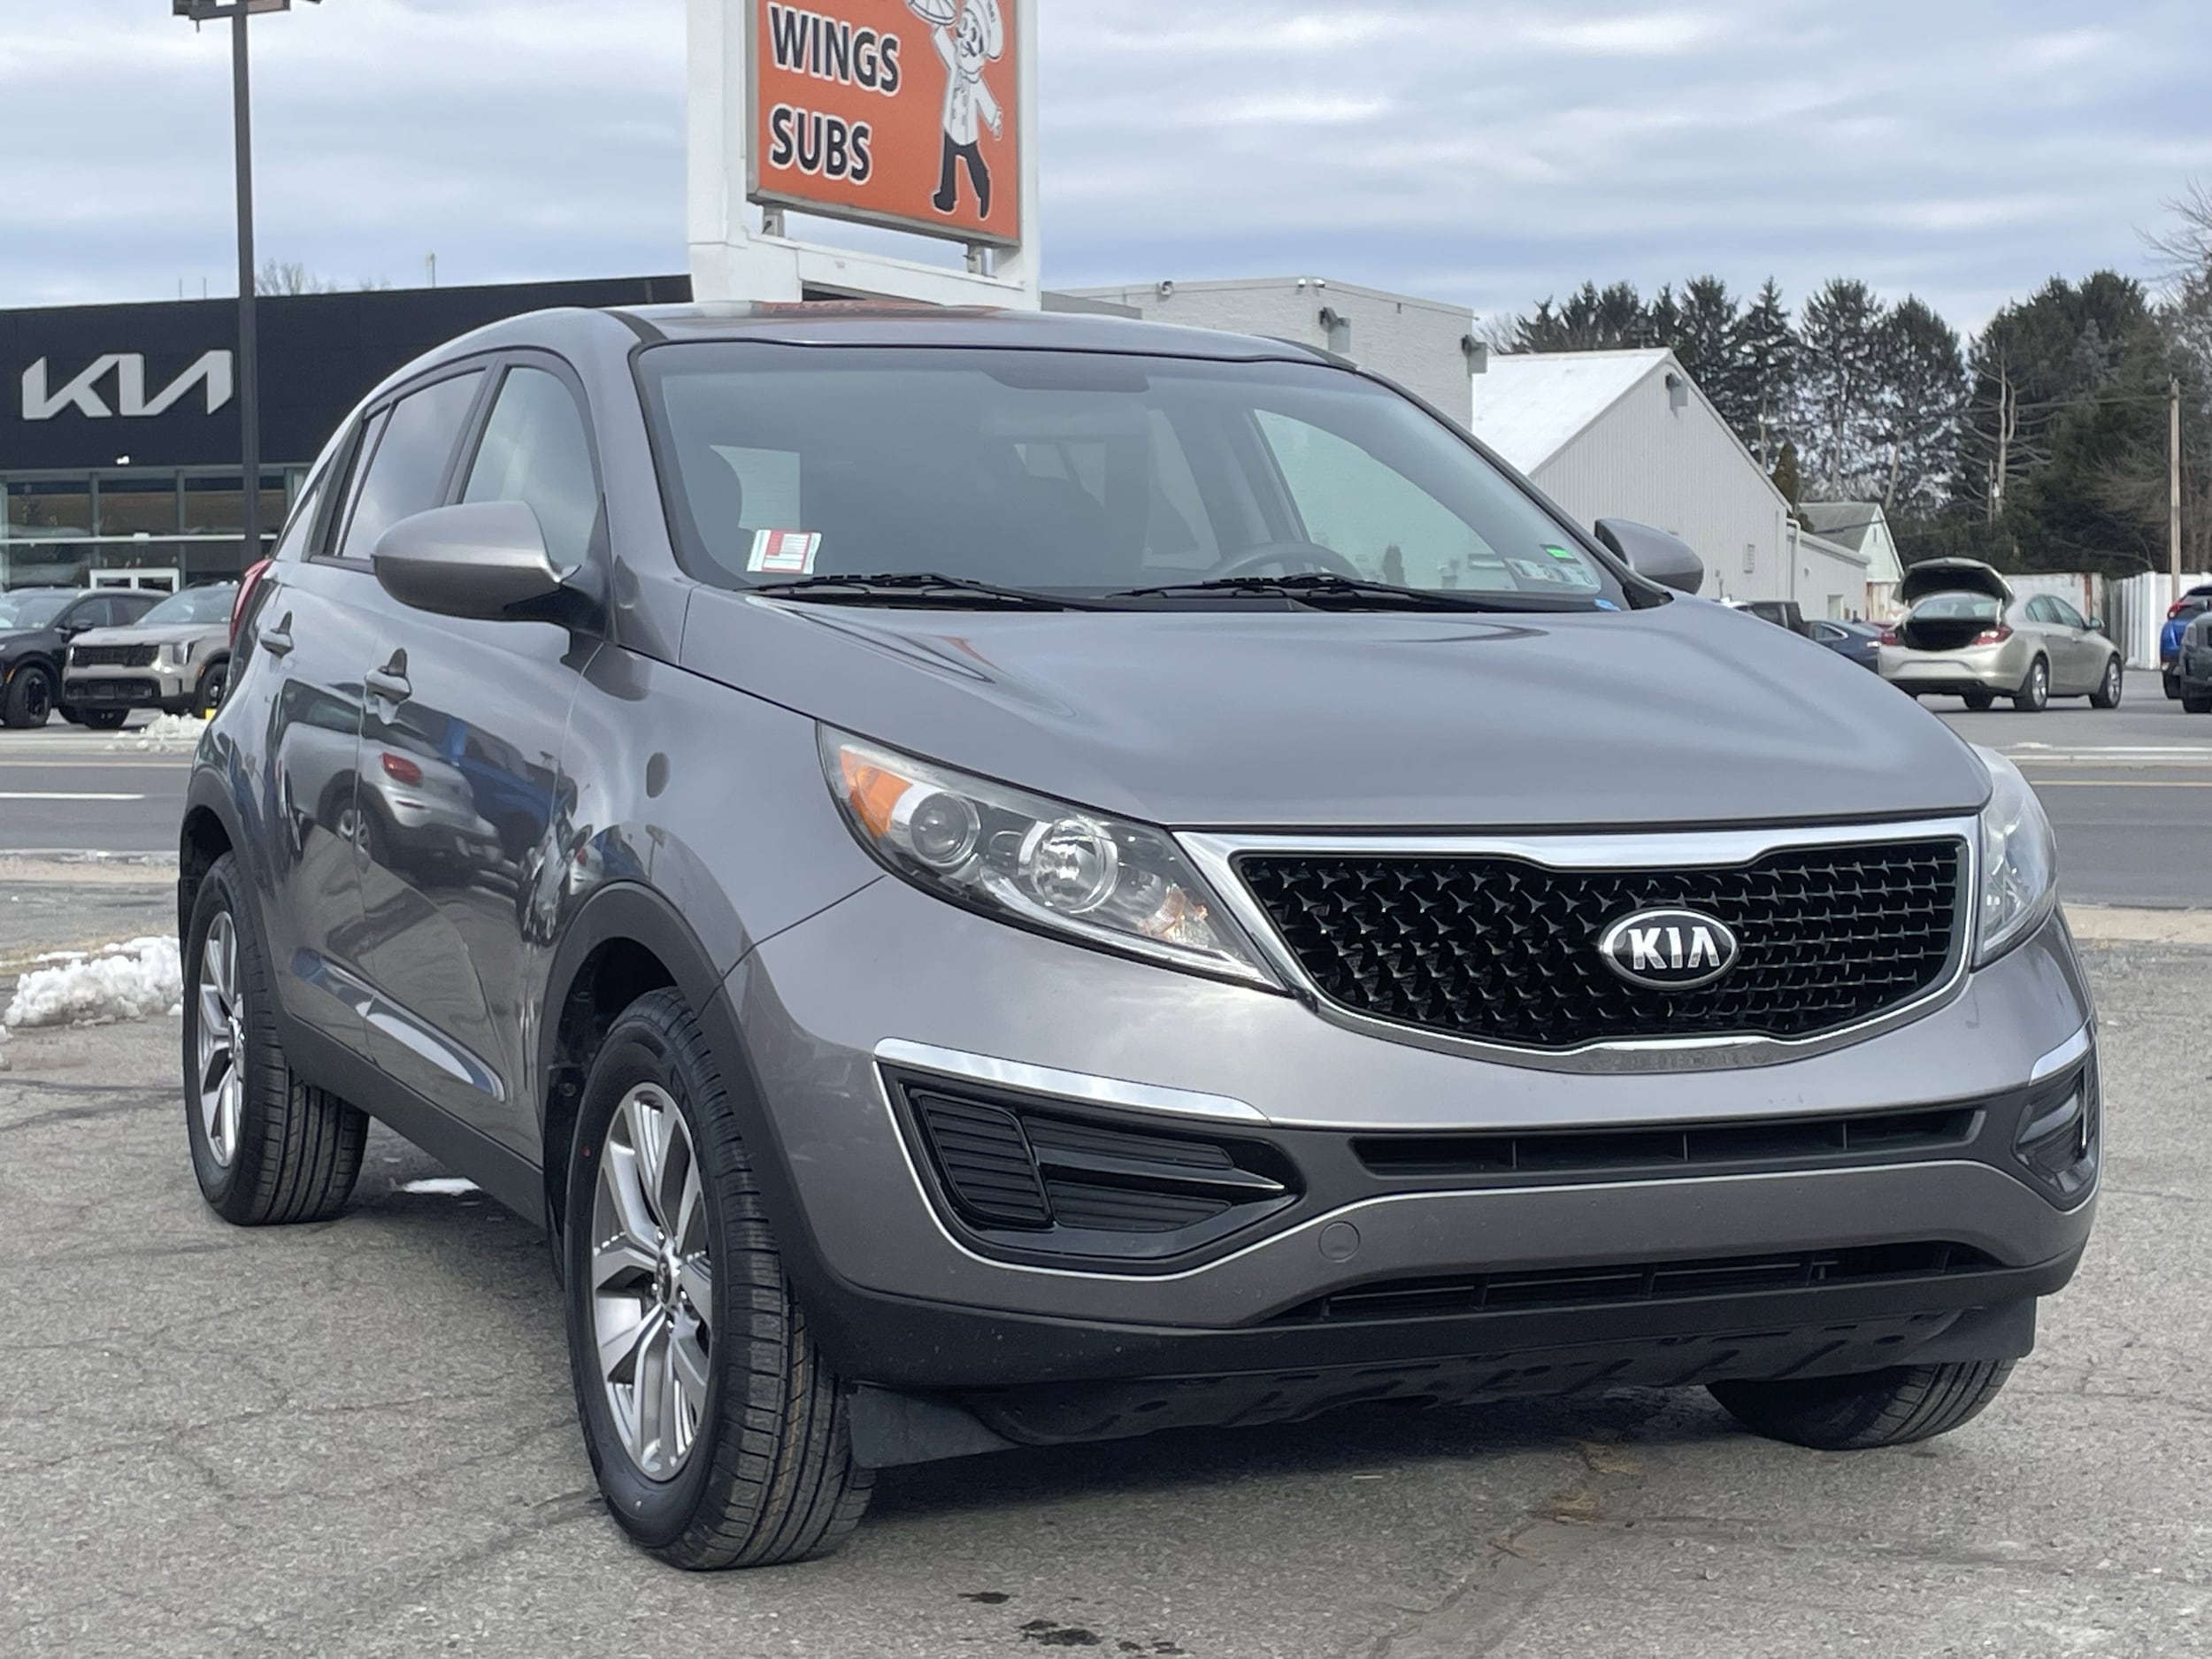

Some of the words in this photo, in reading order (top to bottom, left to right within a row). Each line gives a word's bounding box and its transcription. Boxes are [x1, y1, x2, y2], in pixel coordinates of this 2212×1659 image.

[769, 4, 900, 95] WINGS
[771, 105, 872, 183] SUBS
[21, 349, 234, 420] KIA
[1627, 926, 1721, 971] KIA
